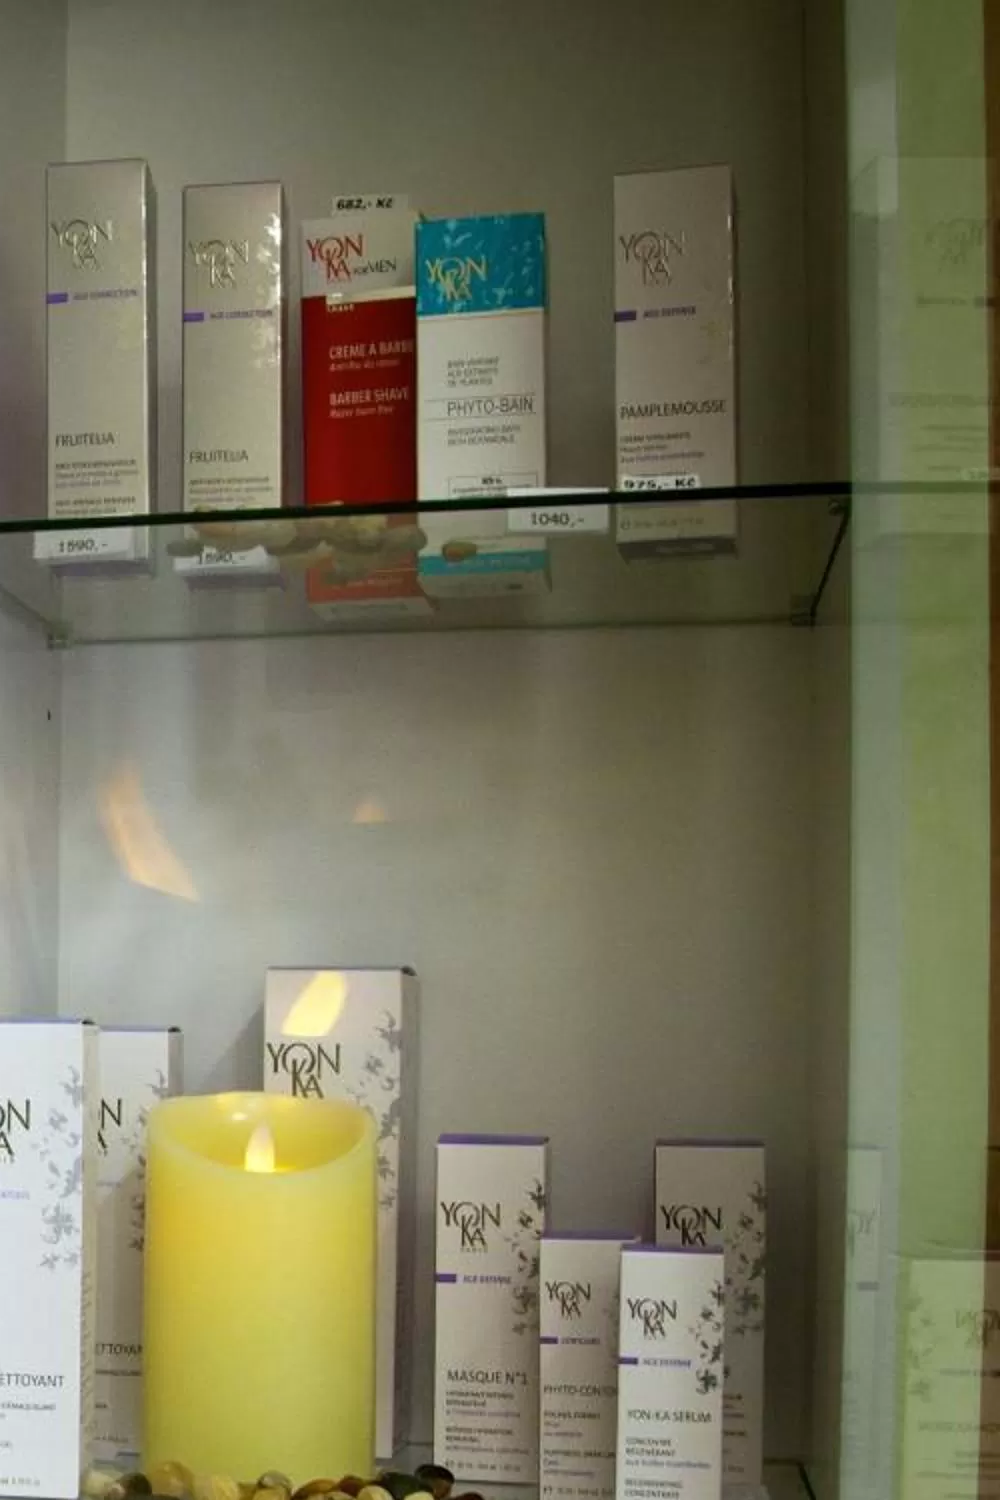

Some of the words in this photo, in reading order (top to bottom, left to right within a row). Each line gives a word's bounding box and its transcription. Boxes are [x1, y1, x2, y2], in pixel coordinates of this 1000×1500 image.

[306, 233, 364, 262] YON
[425, 253, 489, 283] YON
[620, 400, 728, 419] PAMPLEMOUSSE
[531, 511, 585, 528] 1040,-
[266, 1041, 341, 1080] YON
[291, 1058, 325, 1099] KA
[440, 1200, 501, 1229] YON
[660, 1204, 723, 1232] YON
[460, 1213, 487, 1247] KA
[545, 1280, 592, 1302] YON
[627, 1298, 677, 1320] YON
[447, 1369, 502, 1385] MASQUE
[672, 1409, 713, 1423] SERUM
